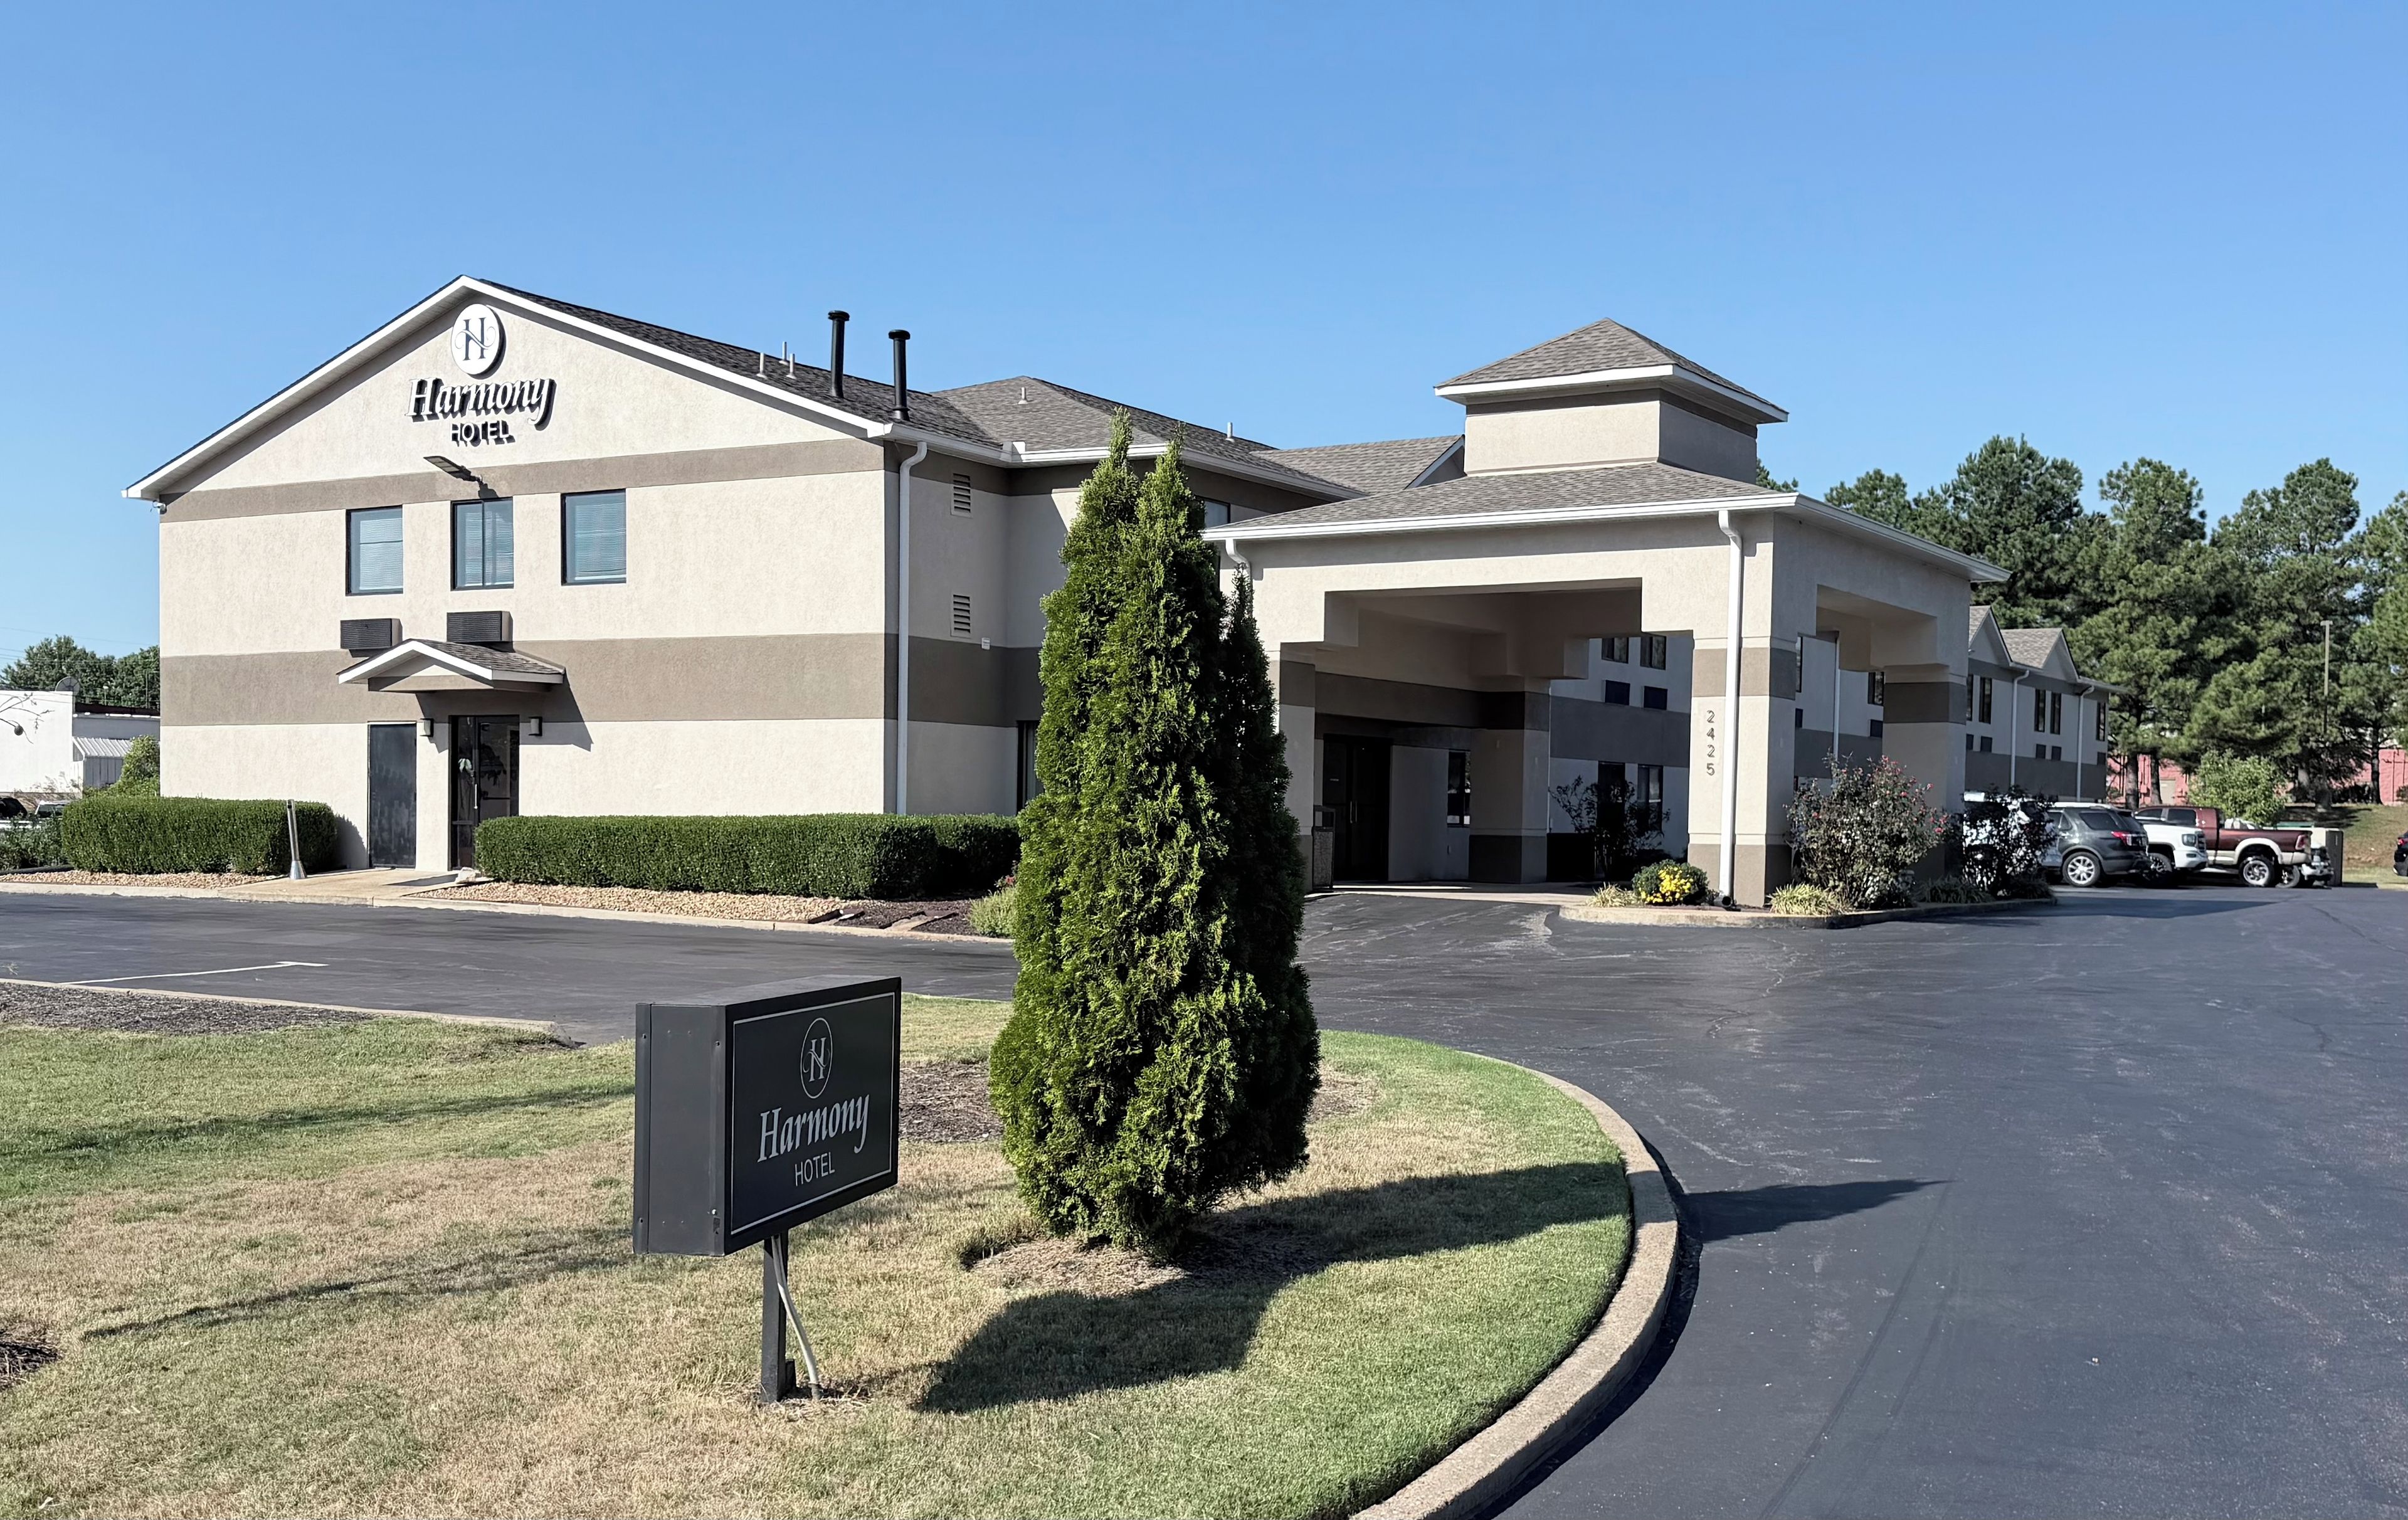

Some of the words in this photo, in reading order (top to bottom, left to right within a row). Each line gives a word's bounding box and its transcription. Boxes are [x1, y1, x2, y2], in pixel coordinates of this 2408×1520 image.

[404, 377, 553, 428] Harmony
[451, 420, 511, 444] HOTEL
[1706, 710, 1716, 776] 2425
[757, 1094, 870, 1163] Harmony
[795, 1151, 835, 1186] HOTEL
